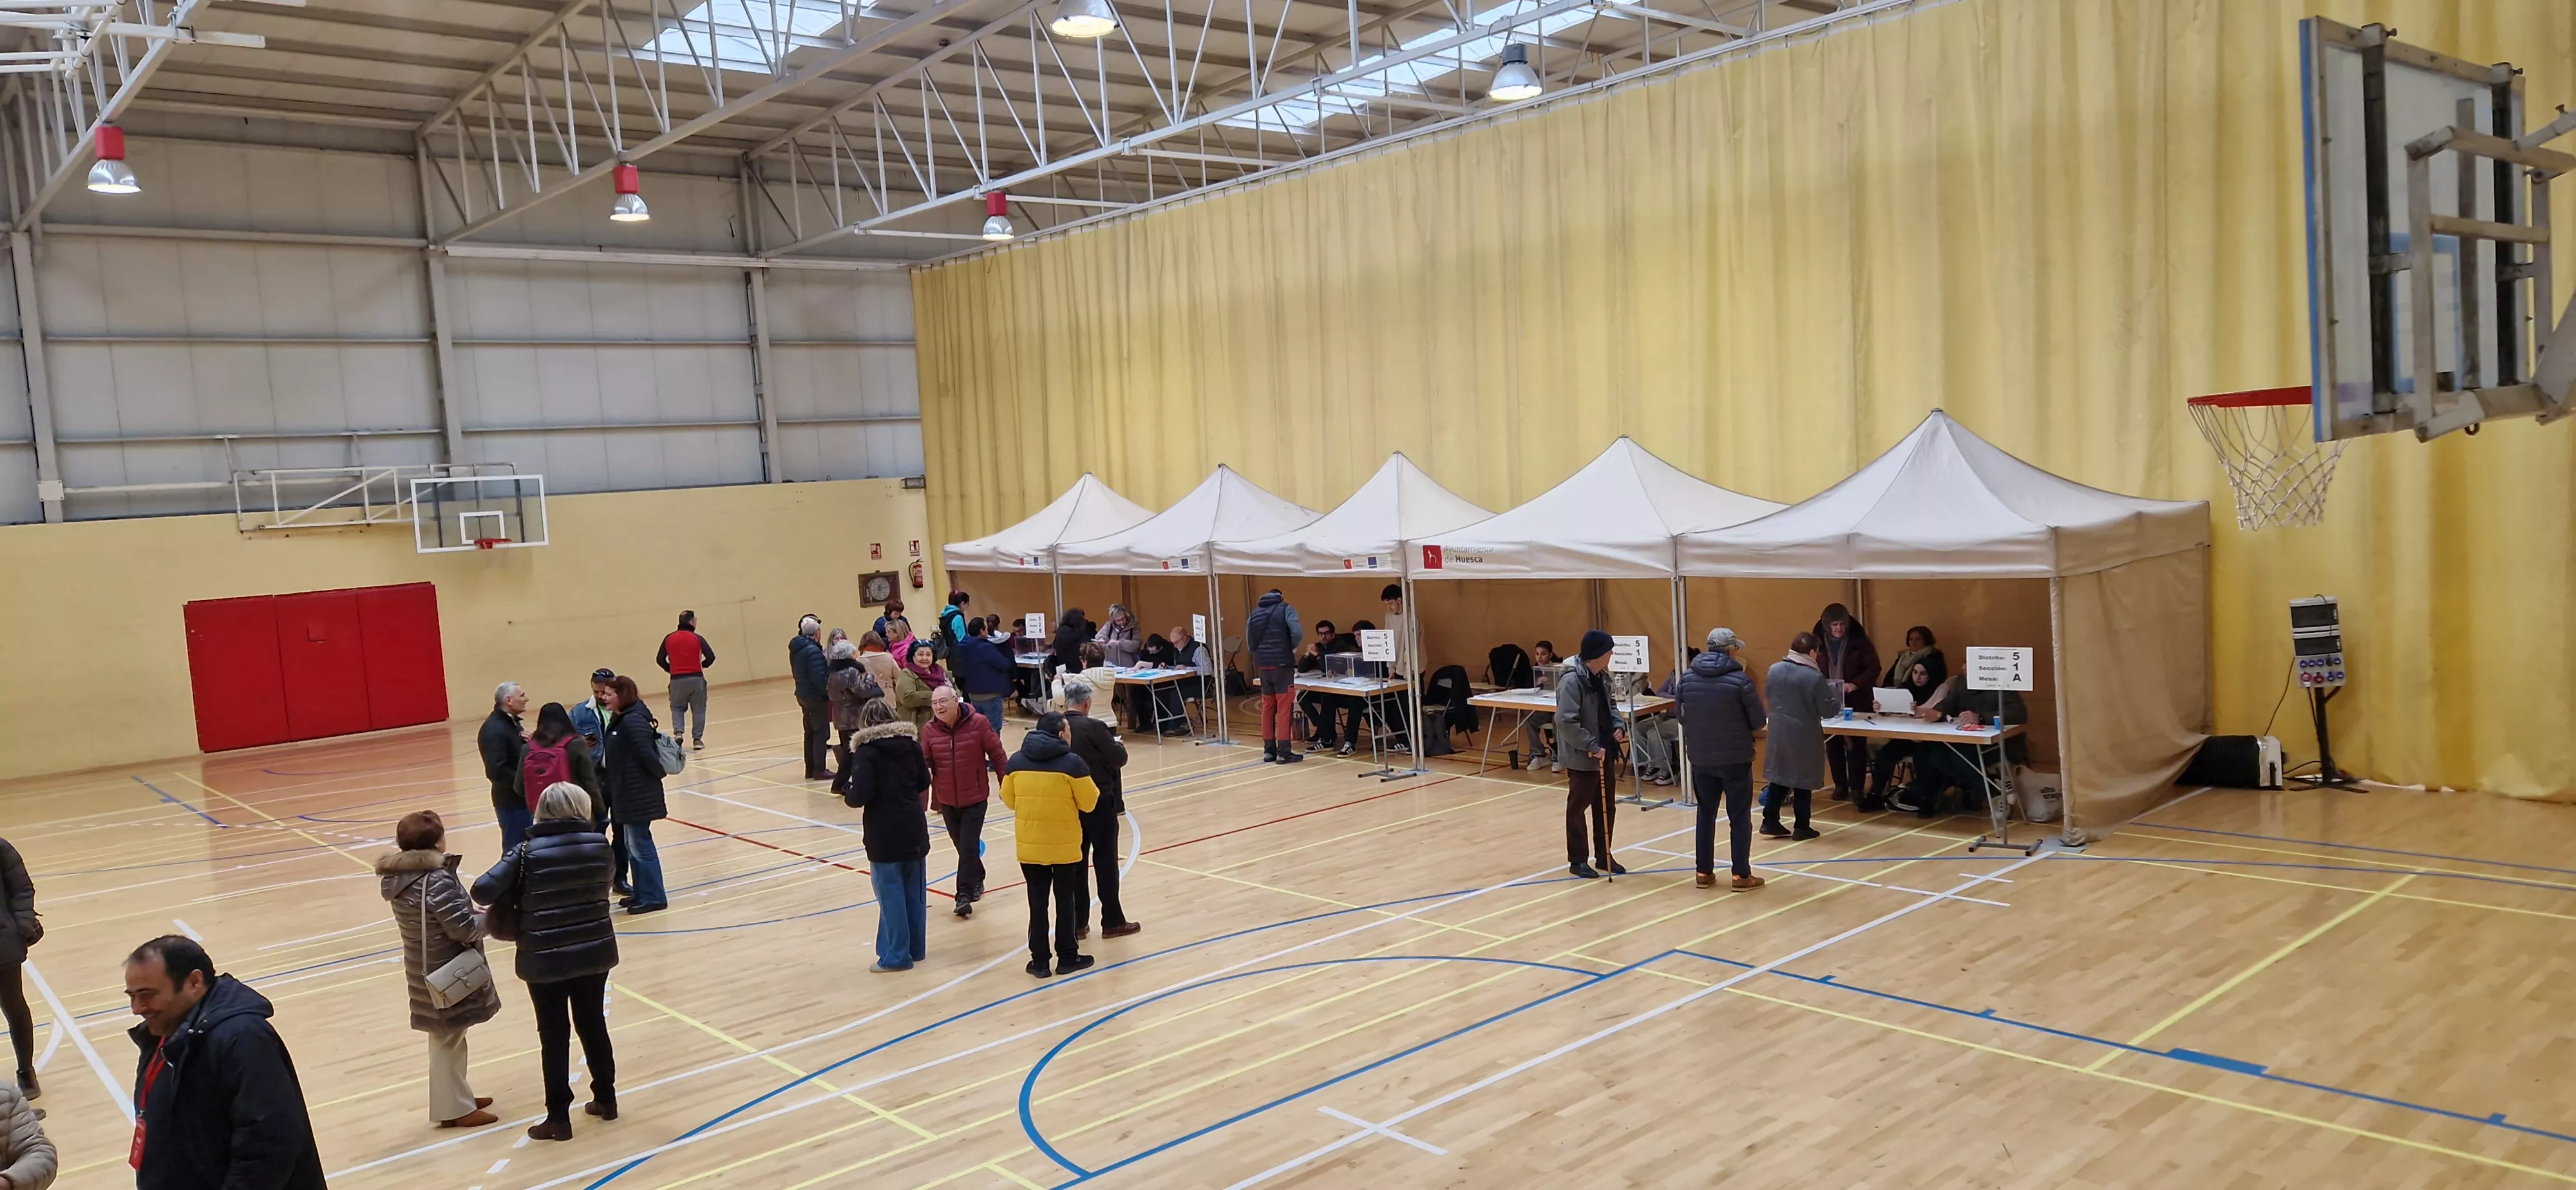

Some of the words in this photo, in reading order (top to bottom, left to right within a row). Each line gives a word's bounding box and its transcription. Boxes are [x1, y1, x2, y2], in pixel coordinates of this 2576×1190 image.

[1443, 545, 1493, 554] Ayuntamiento
[1455, 555, 1483, 563] Huesca
[2012, 652, 2020, 661] 5
[2012, 662, 2019, 671] 1
[2012, 673, 2022, 681] A
